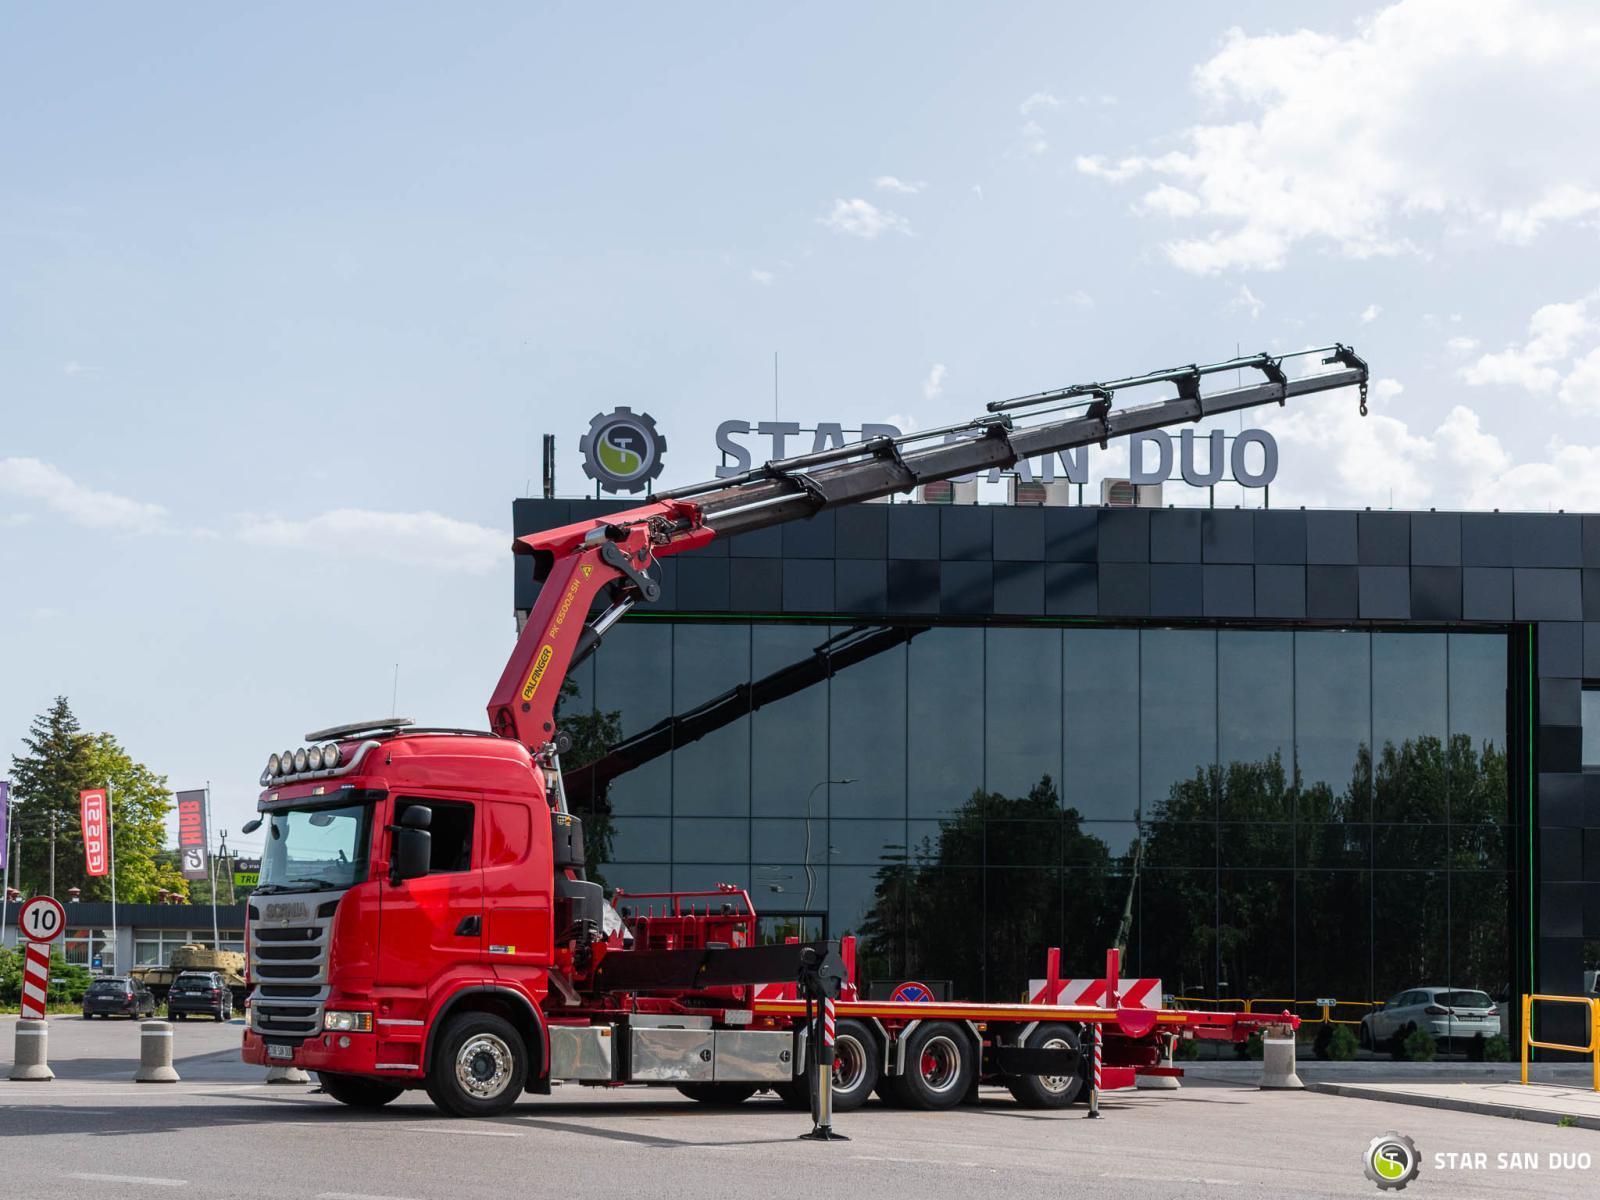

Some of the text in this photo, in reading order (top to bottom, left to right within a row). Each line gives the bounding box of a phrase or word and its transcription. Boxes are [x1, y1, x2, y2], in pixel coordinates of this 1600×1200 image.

[1129, 428, 1279, 488] DUO
[523, 647, 552, 699] PALFINGER
[31, 908, 56, 931] 10
